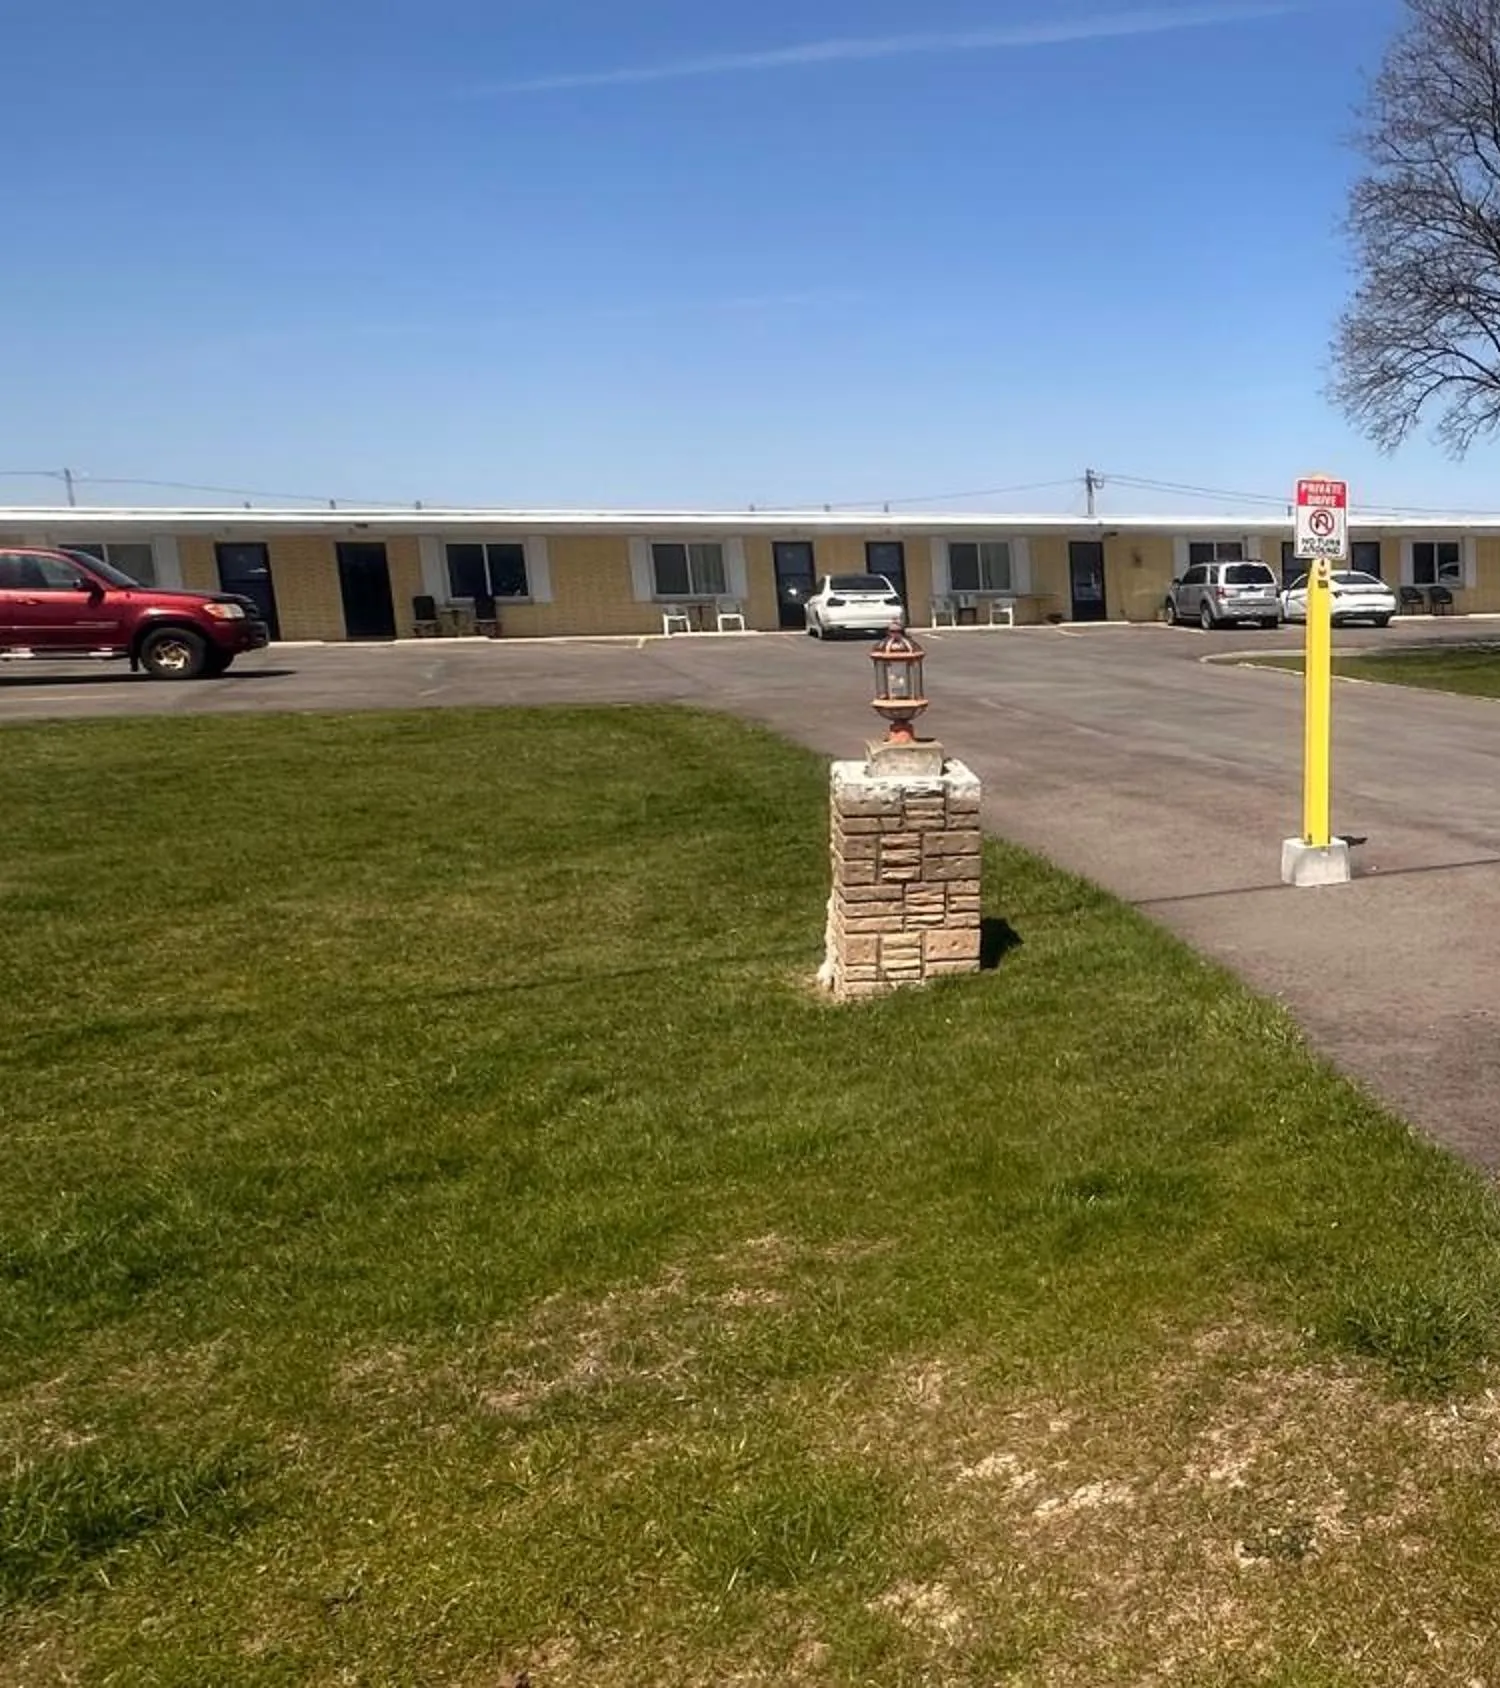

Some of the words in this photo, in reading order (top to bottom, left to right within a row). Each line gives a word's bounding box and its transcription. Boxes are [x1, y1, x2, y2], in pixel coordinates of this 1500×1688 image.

[1301, 482, 1344, 494] PRIVATE
[1308, 495, 1337, 505] DRIVE
[1317, 538, 1340, 546] TURN
[1302, 546, 1340, 554] AROUND
